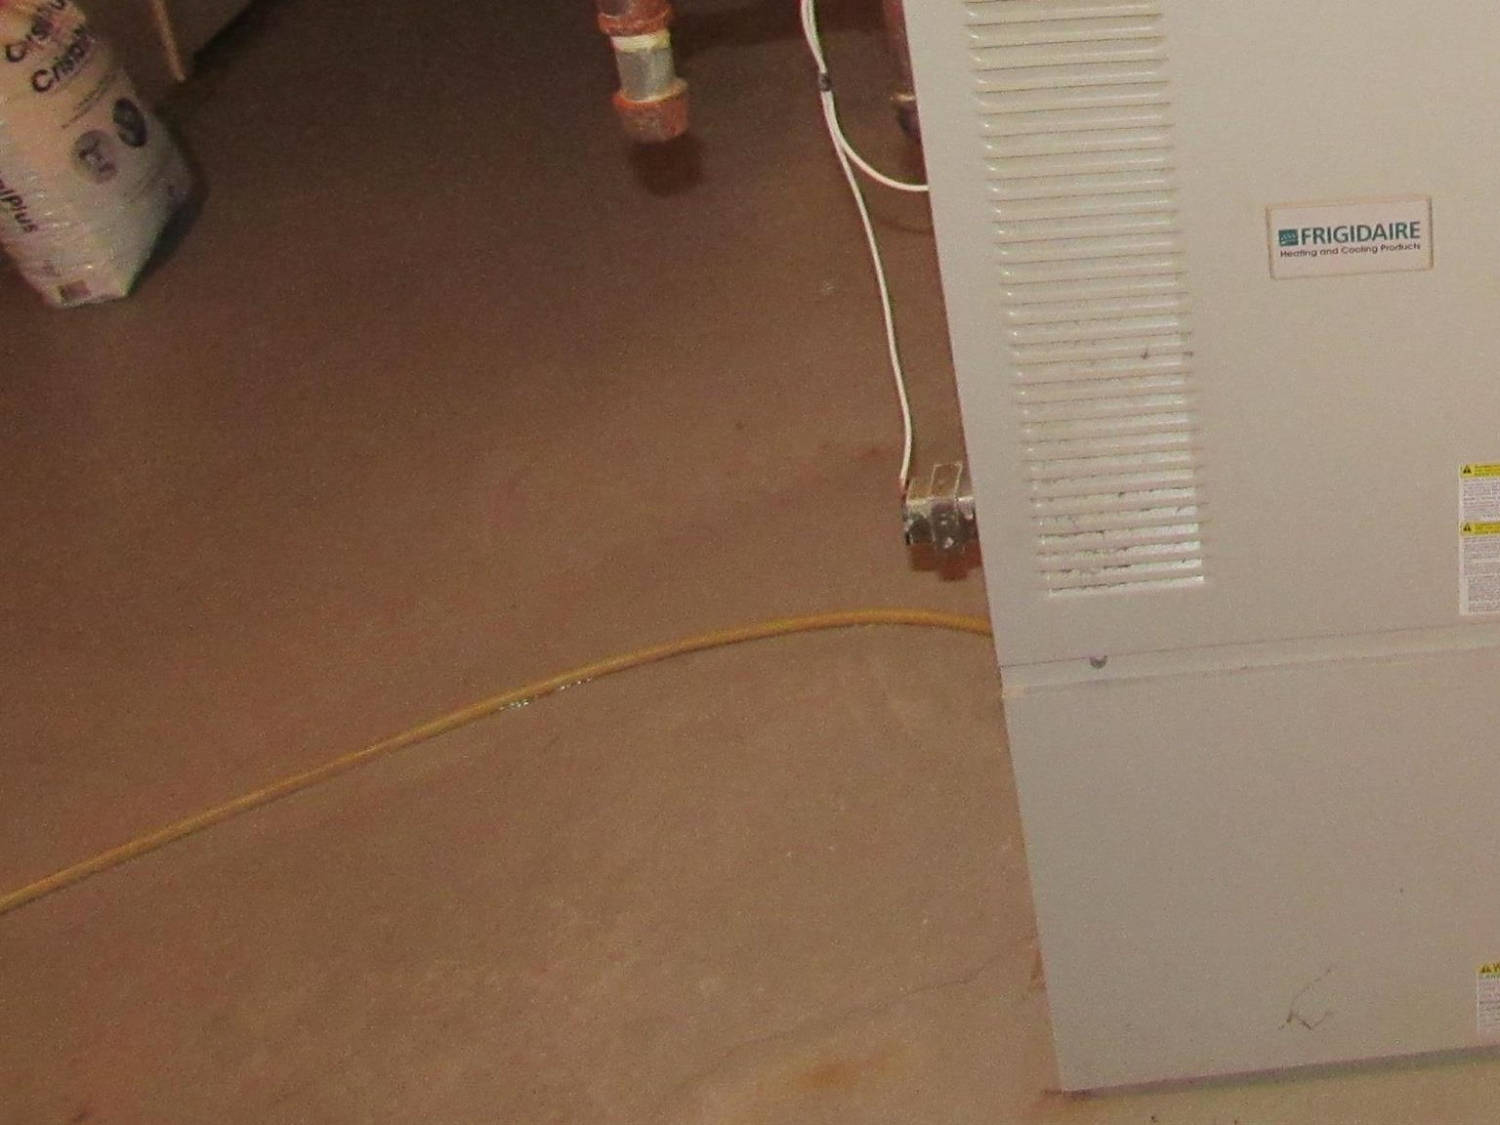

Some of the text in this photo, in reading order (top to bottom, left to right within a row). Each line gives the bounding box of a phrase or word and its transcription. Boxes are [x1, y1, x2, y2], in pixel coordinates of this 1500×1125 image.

[1301, 221, 1421, 245] FRIGIDAIRE
[1280, 242, 1421, 258] Heating and Cooling Products
